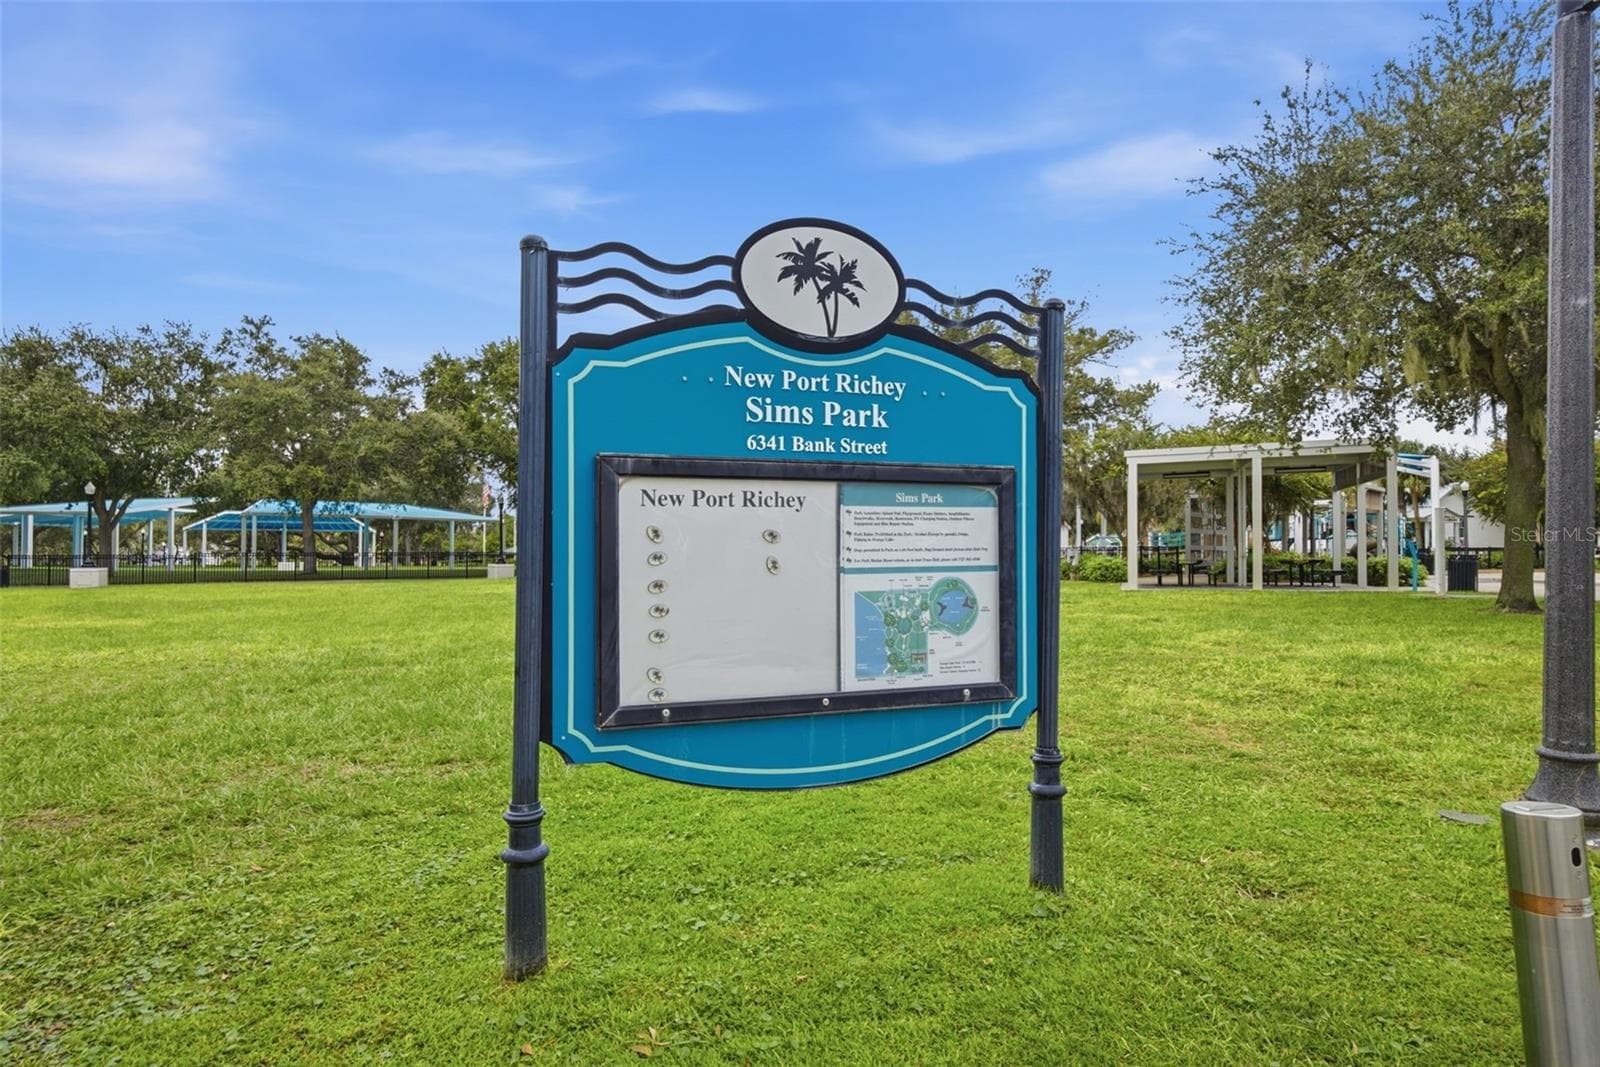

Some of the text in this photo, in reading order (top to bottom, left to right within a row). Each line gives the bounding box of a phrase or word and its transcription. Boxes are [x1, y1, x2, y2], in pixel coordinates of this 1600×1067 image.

[724, 365, 906, 401] New Port Richey
[745, 396, 889, 429] Sims Park
[746, 435, 888, 455] 6341 Bank Street
[640, 488, 807, 512] New Port Richey
[895, 492, 944, 504] Sims Park
